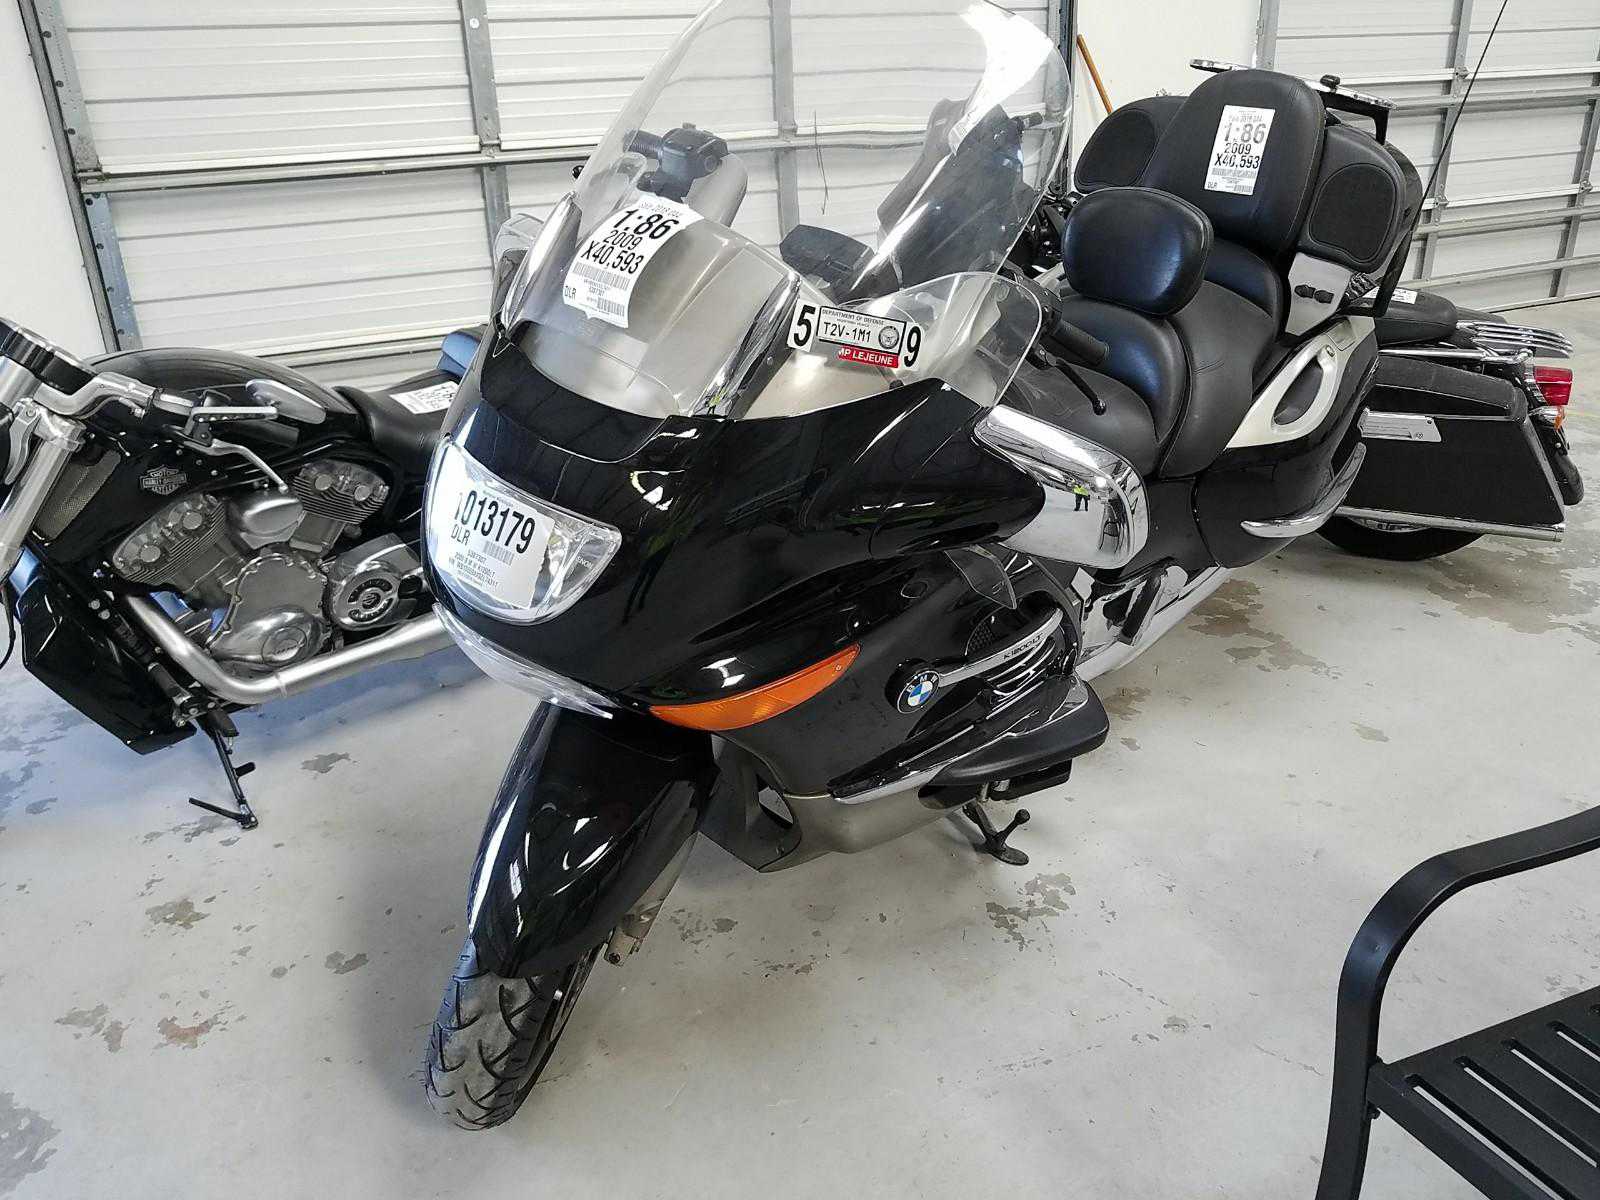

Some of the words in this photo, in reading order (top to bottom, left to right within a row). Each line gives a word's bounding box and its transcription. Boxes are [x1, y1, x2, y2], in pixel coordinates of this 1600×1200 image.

[1224, 122, 1266, 144] 1:86
[1224, 142, 1252, 155] 2009
[1207, 181, 1218, 189] DLR
[613, 208, 679, 240] 1:86
[603, 229, 643, 251] 2009
[564, 285, 577, 300] DLR
[793, 304, 816, 347] 5
[822, 308, 855, 320] DEPARTMENT
[864, 317, 884, 326] DEFENSE
[824, 321, 871, 343] T2V-1M1
[852, 350, 893, 365] LEJEUNE
[903, 326, 922, 368] 9
[451, 523, 471, 546] DLR
[906, 674, 939, 693] BMW
